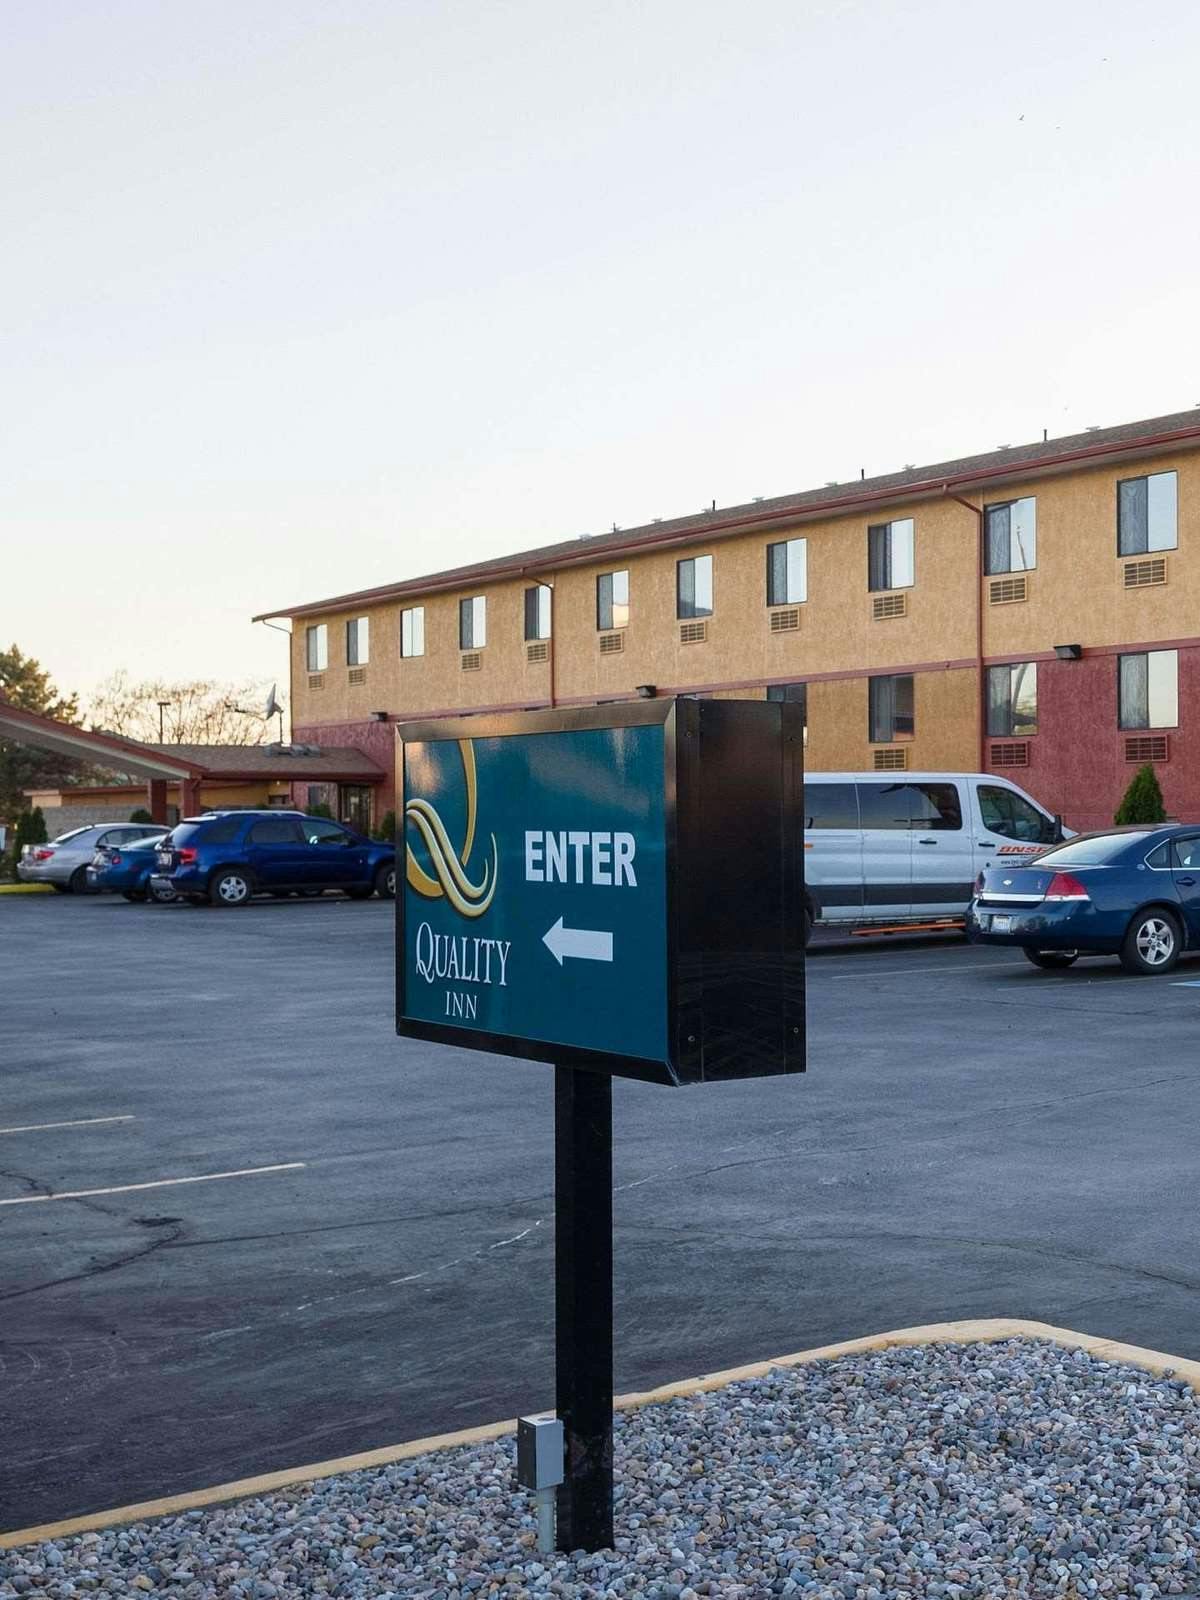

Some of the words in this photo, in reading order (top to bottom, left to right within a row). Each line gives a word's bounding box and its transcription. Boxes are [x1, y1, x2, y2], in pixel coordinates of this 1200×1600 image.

[525, 830, 638, 887] ENTER
[415, 921, 512, 987] QUALITY
[444, 990, 478, 1021] INN
